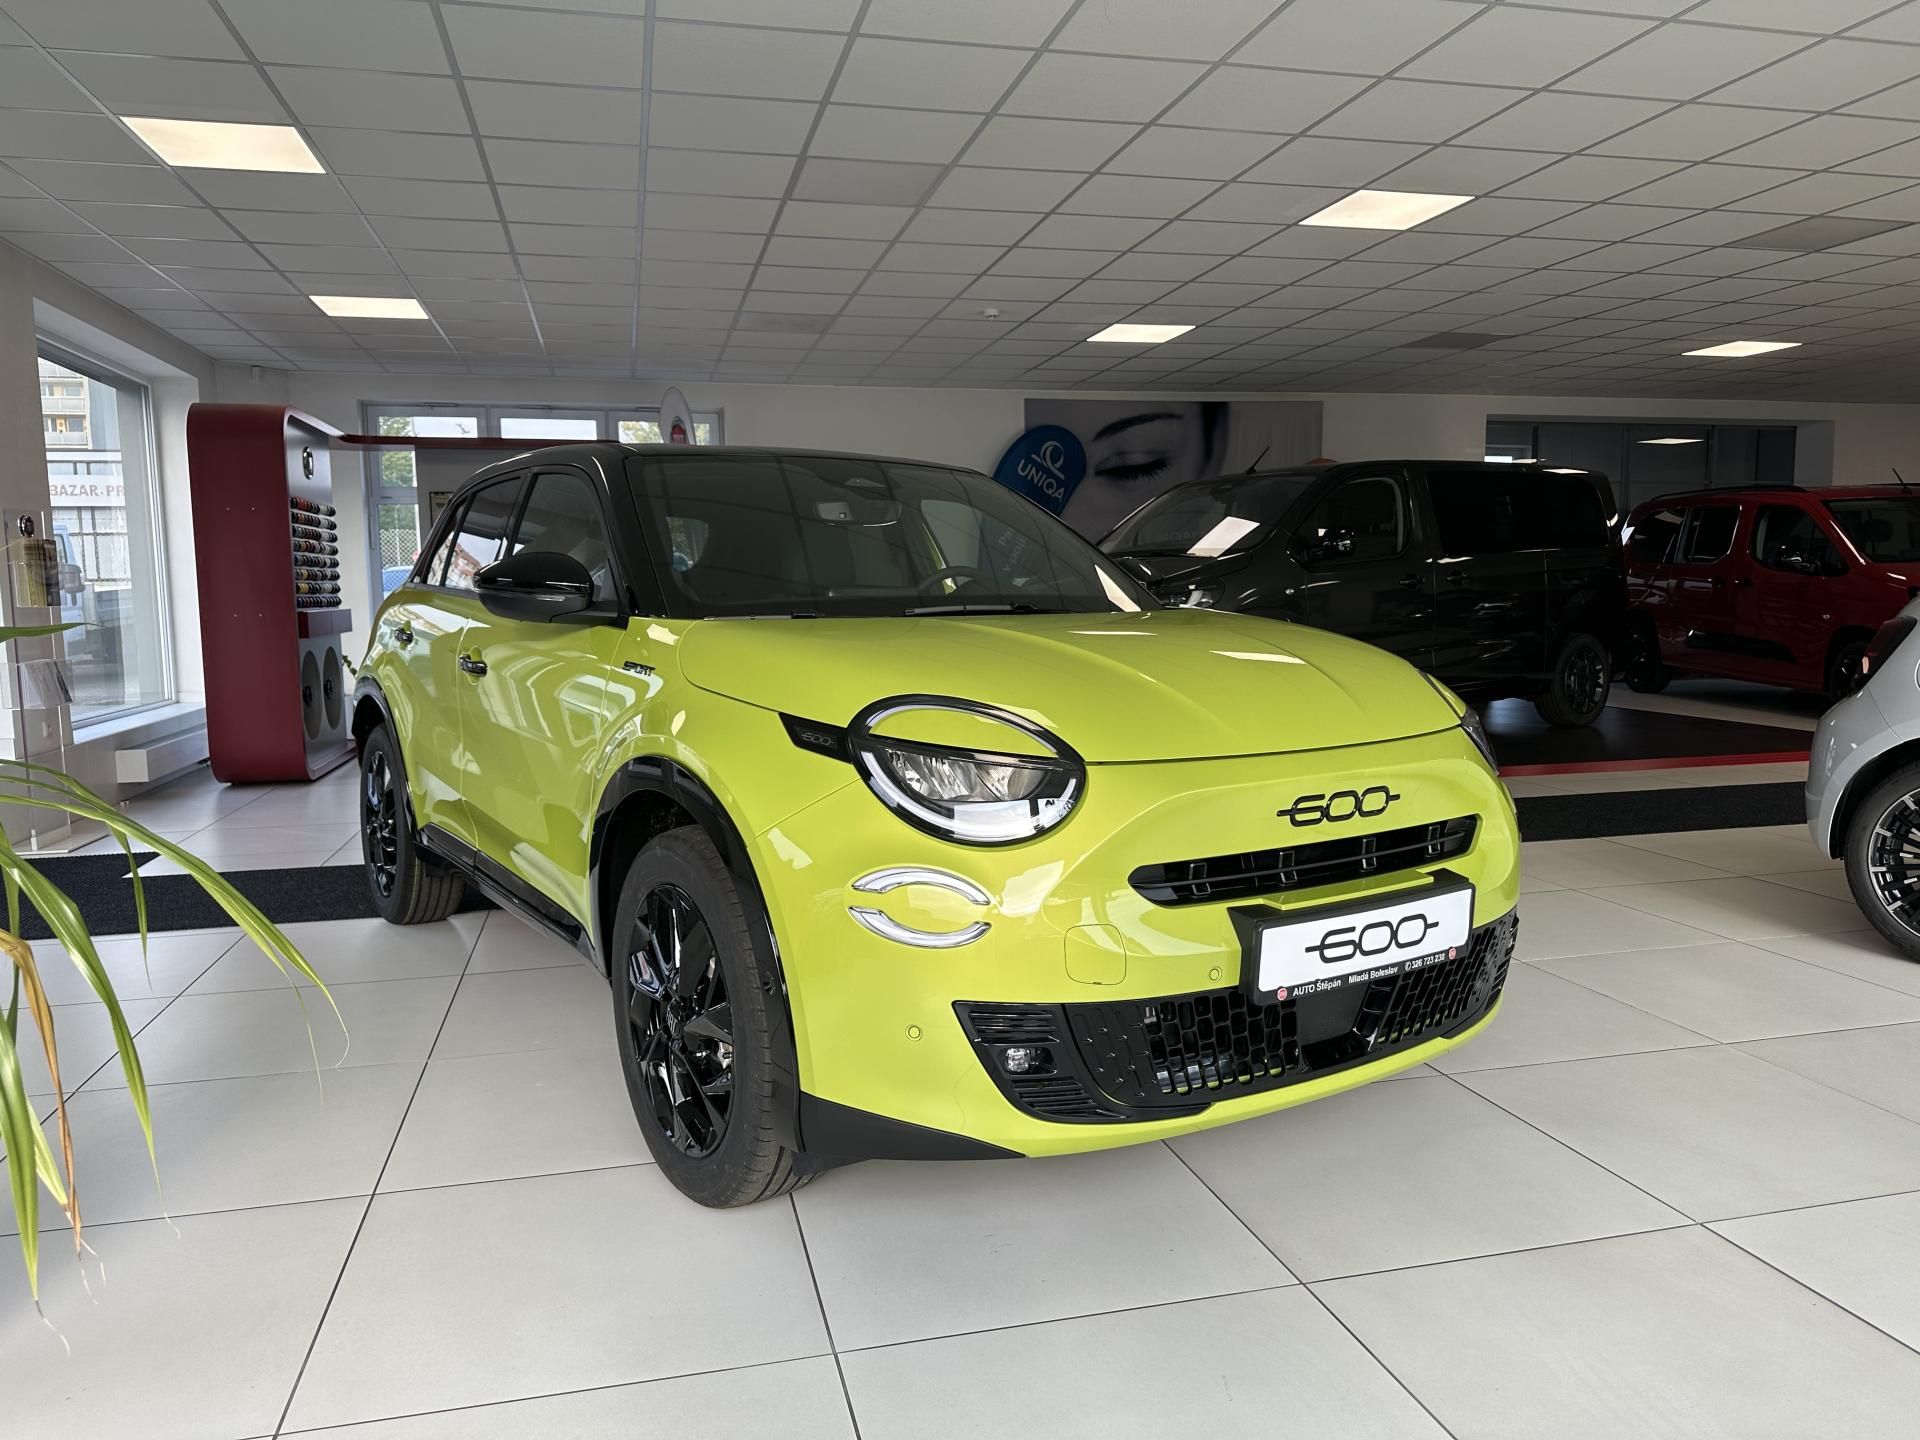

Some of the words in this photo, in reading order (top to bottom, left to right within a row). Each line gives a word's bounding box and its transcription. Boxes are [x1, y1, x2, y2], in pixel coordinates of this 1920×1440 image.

[1017, 459, 1065, 503] UNIQA
[622, 660, 656, 677] SPORT
[1277, 785, 1400, 827] 600
[1305, 912, 1439, 964] 600
[1292, 984, 1315, 997] AUTO
[1316, 979, 1342, 991] Štěpán
[1348, 971, 1369, 984] Mladá
[1370, 966, 1398, 979] Boleslav
[1423, 955, 1434, 965] 723
[1434, 953, 1446, 962] 230
